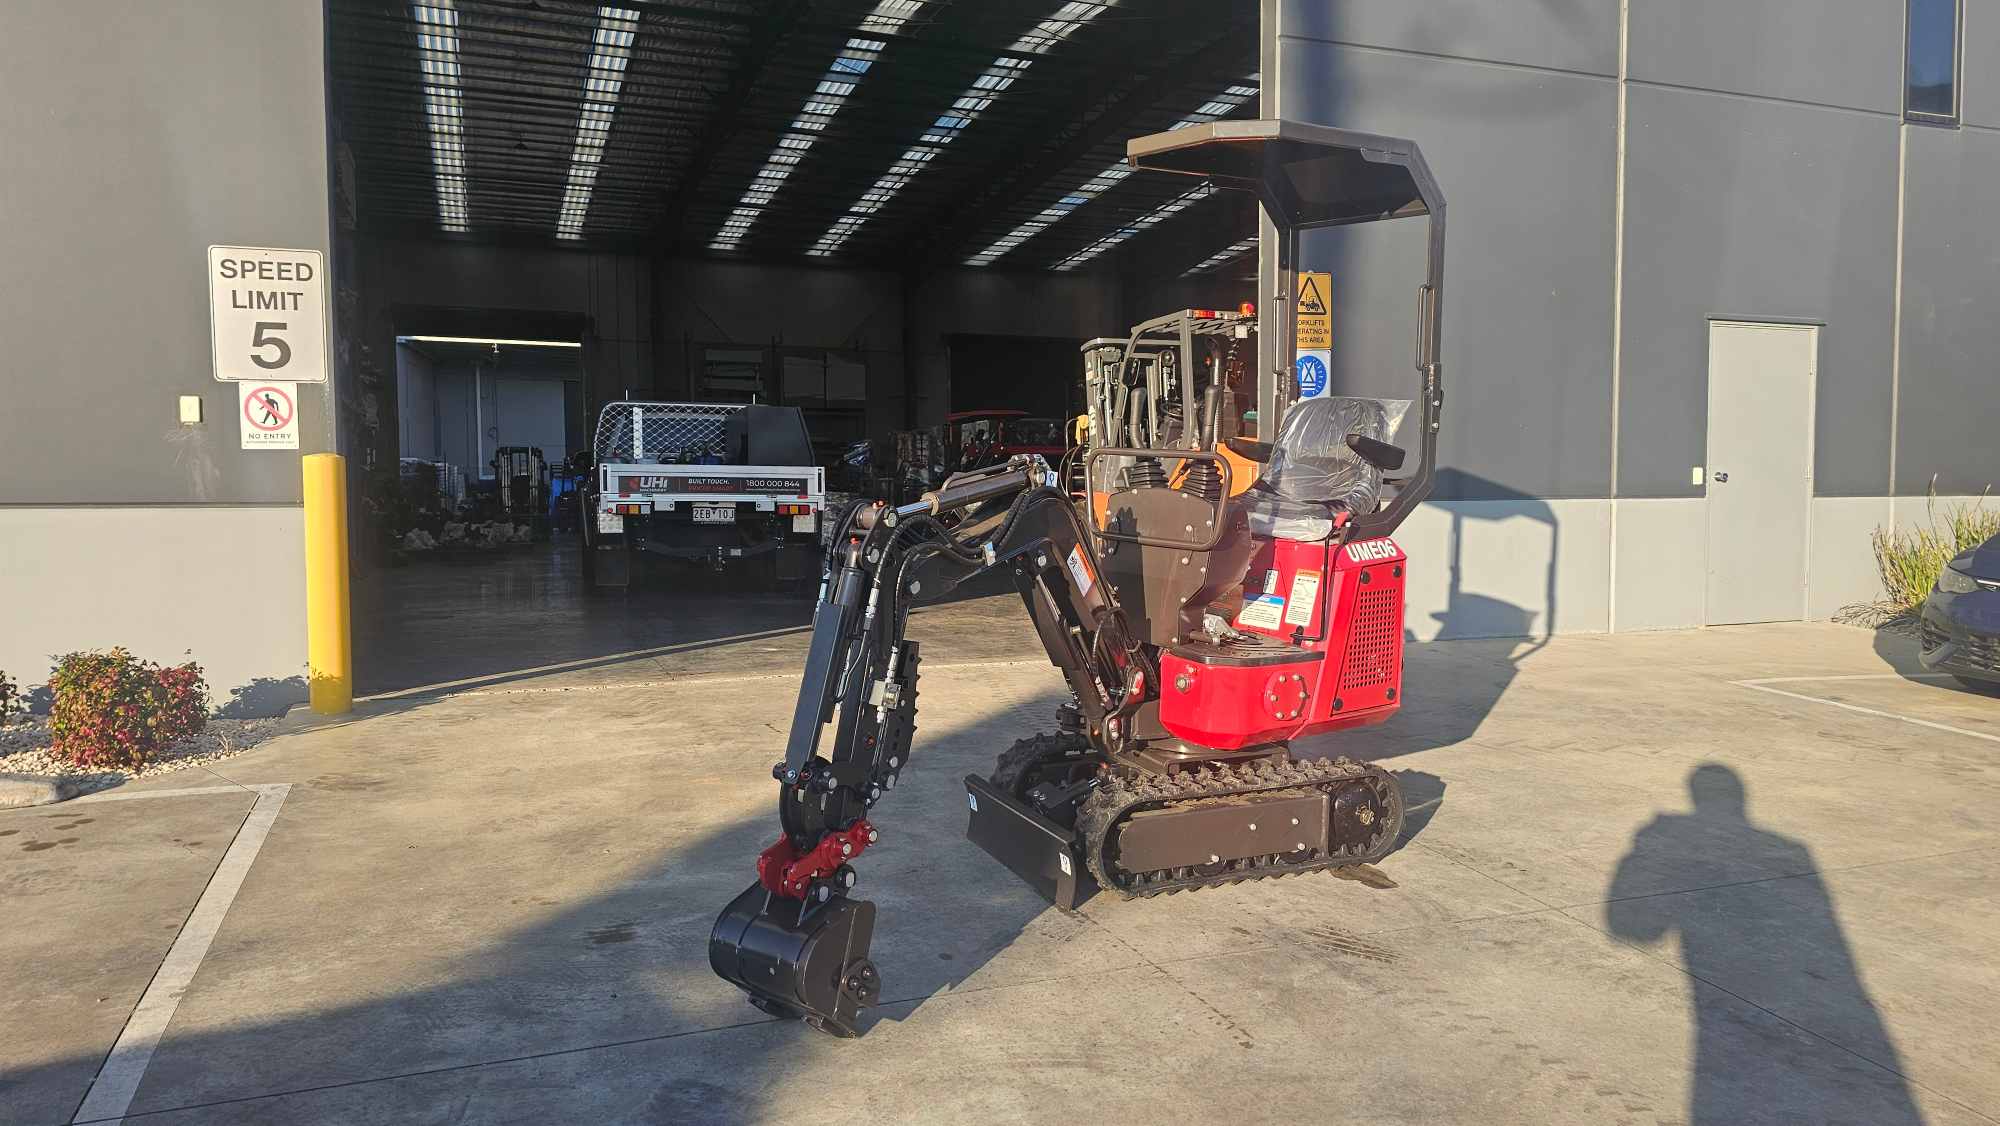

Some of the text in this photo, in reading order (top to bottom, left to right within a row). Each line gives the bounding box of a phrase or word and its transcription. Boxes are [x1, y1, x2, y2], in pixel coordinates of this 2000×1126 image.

[220, 259, 313, 281] SPEED
[232, 290, 303, 311] LIMIT
[251, 322, 291, 369] 5
[1345, 539, 1398, 562] UME06
